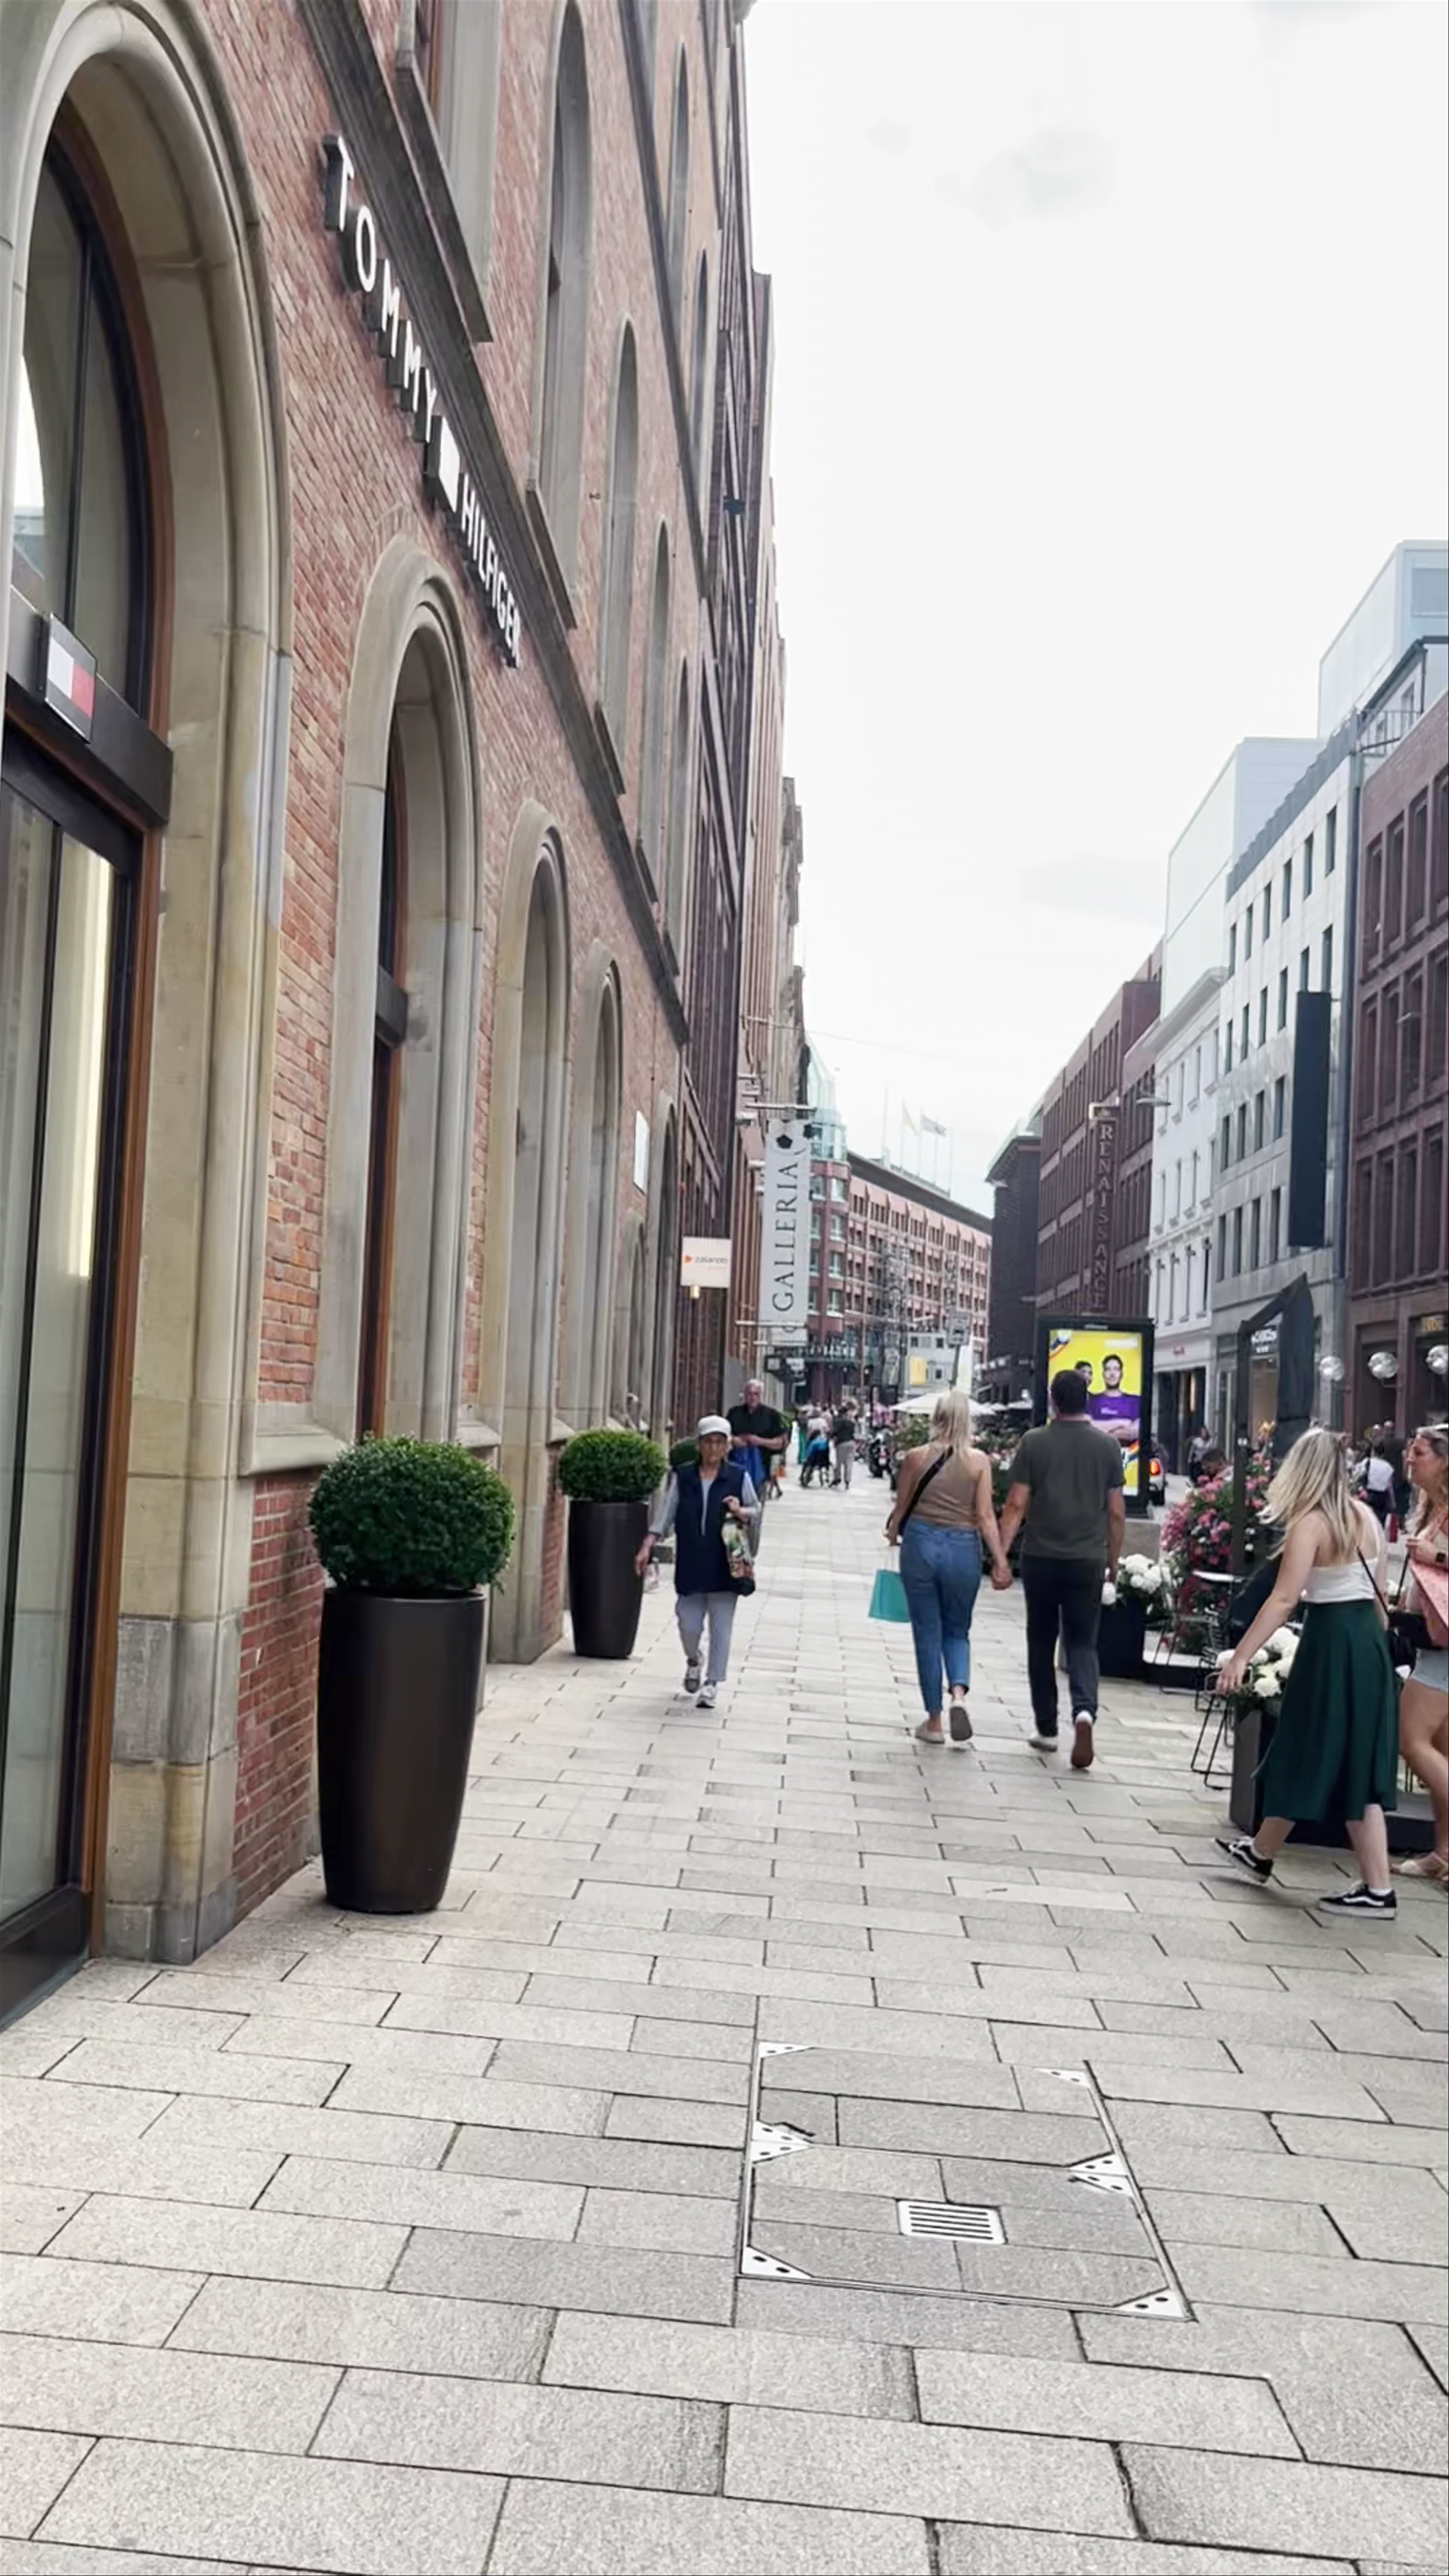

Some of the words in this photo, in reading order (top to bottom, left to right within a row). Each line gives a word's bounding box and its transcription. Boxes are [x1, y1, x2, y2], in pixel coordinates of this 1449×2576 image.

[338, 135, 437, 443] TOMMY
[461, 472, 520, 669] HILFIGER
[772, 1162, 798, 1312] GALLERIA
[1094, 1124, 1113, 1309] RENAISSANCE
